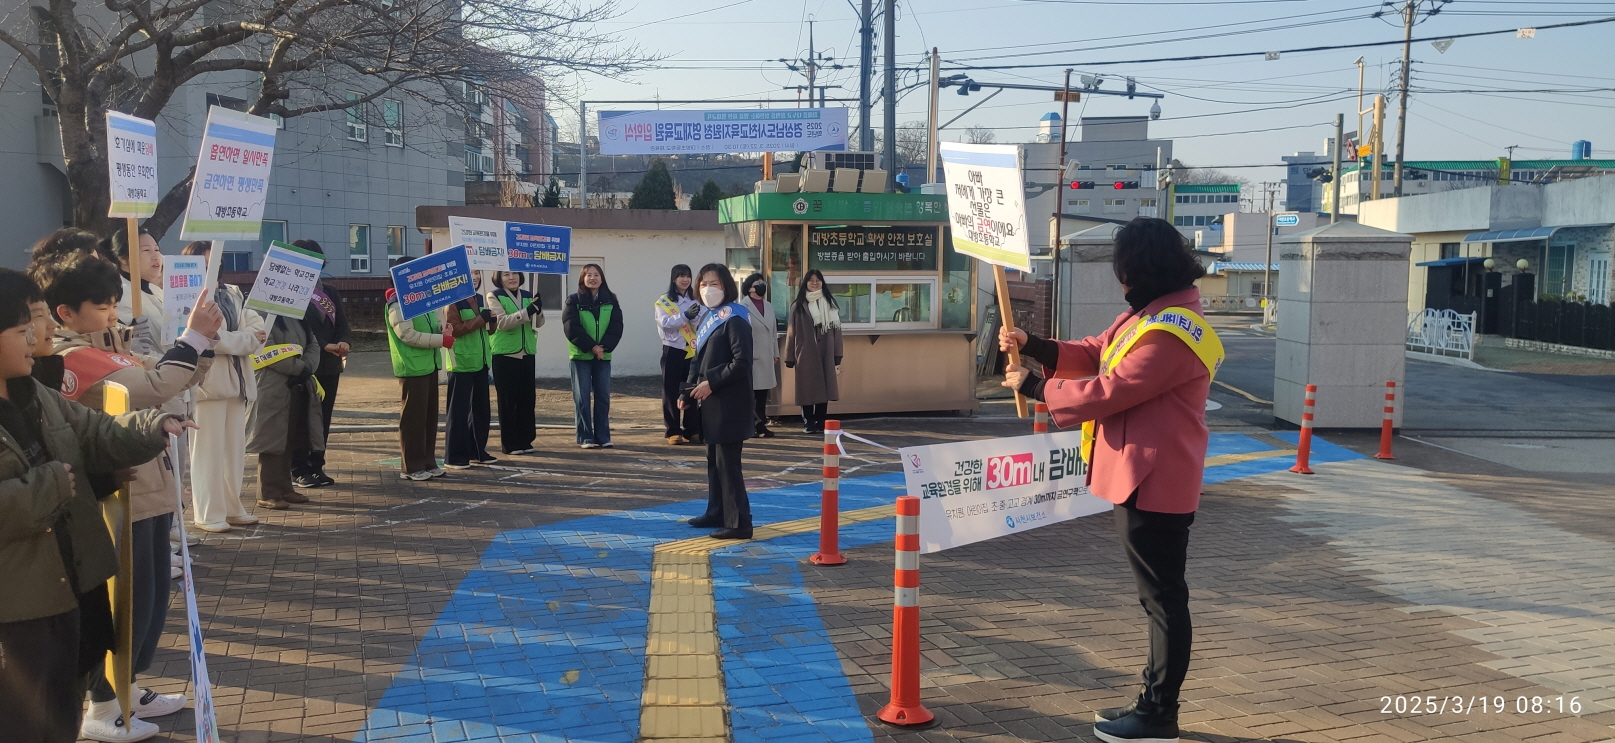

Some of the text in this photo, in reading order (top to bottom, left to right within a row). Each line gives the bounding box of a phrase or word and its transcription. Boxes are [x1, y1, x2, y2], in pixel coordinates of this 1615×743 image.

[210, 143, 269, 167] 흡연하면 일시만족
[204, 173, 264, 194] 금연하면 평생만족
[996, 189, 1004, 206] 큰
[917, 201, 941, 214] 행복한
[812, 232, 933, 247] 대방초등학교 학생 안전 보호실
[533, 250, 567, 262] 담배금지!
[846, 251, 861, 262] 받아
[862, 251, 897, 262] 출입하시기
[898, 251, 926, 261] 바랍니다
[431, 273, 469, 296] 담배금지!
[954, 458, 983, 477] 건강한
[920, 476, 982, 500] 교육환경을 위해
[1033, 491, 1057, 504] 30m까지
[1015, 512, 1047, 525] 사천시보건소
